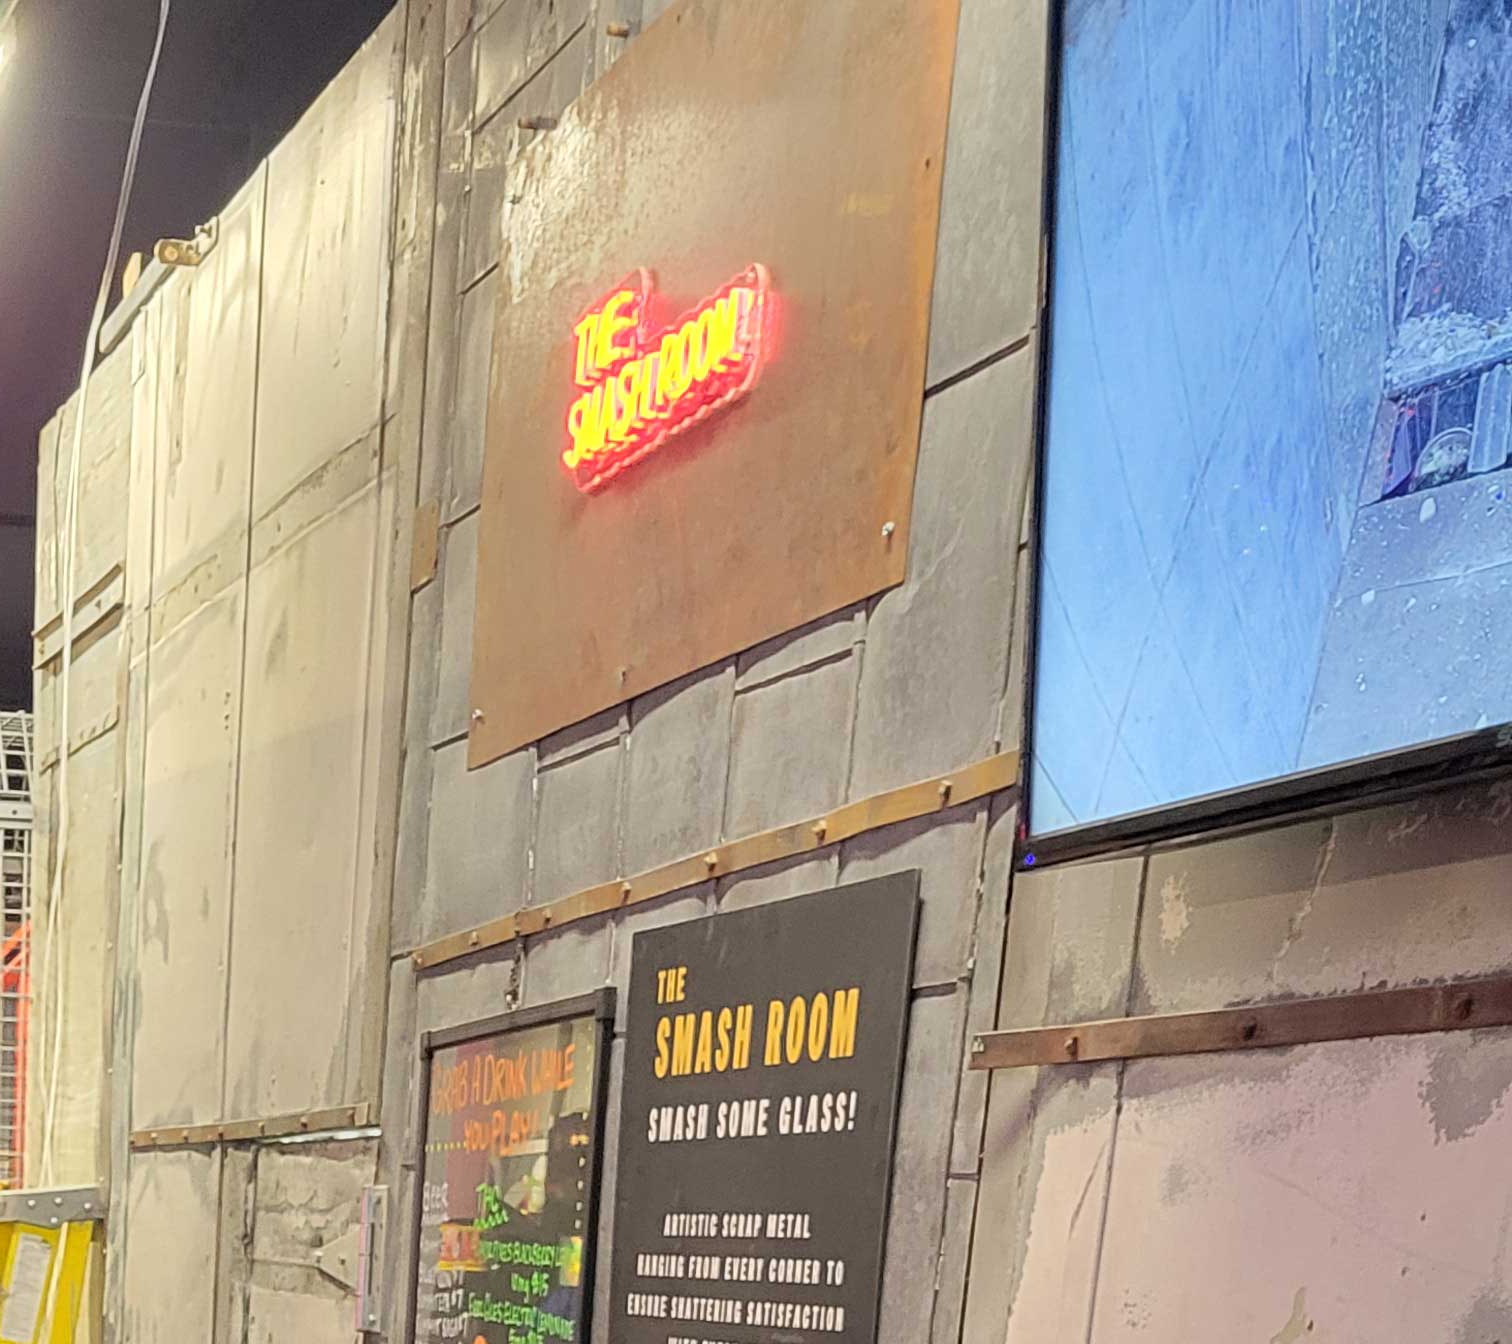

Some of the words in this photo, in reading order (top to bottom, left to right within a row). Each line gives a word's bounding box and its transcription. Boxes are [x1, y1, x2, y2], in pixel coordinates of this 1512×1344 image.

[574, 290, 635, 386] THE
[657, 966, 687, 1004] THE
[654, 1005, 753, 1079] SMASH
[763, 987, 860, 1066] ROOM
[483, 1049, 528, 1105] DRINK
[648, 1103, 709, 1142] SMASH
[716, 1099, 770, 1139] SOME
[779, 1090, 858, 1135] GLASS!
[663, 1213, 718, 1237] ARTISTIC
[721, 1213, 763, 1238] SCRAP
[766, 1214, 811, 1239] METAL
[637, 1253, 685, 1278] HANGING
[688, 1255, 721, 1280] FROM
[724, 1256, 764, 1281] EVERY
[768, 1258, 821, 1284] CORNER
[826, 1260, 844, 1286] TO
[627, 1293, 668, 1318] ENSURE
[670, 1296, 742, 1324] SHATTERING
[746, 1301, 844, 1332] SATISFACTION
